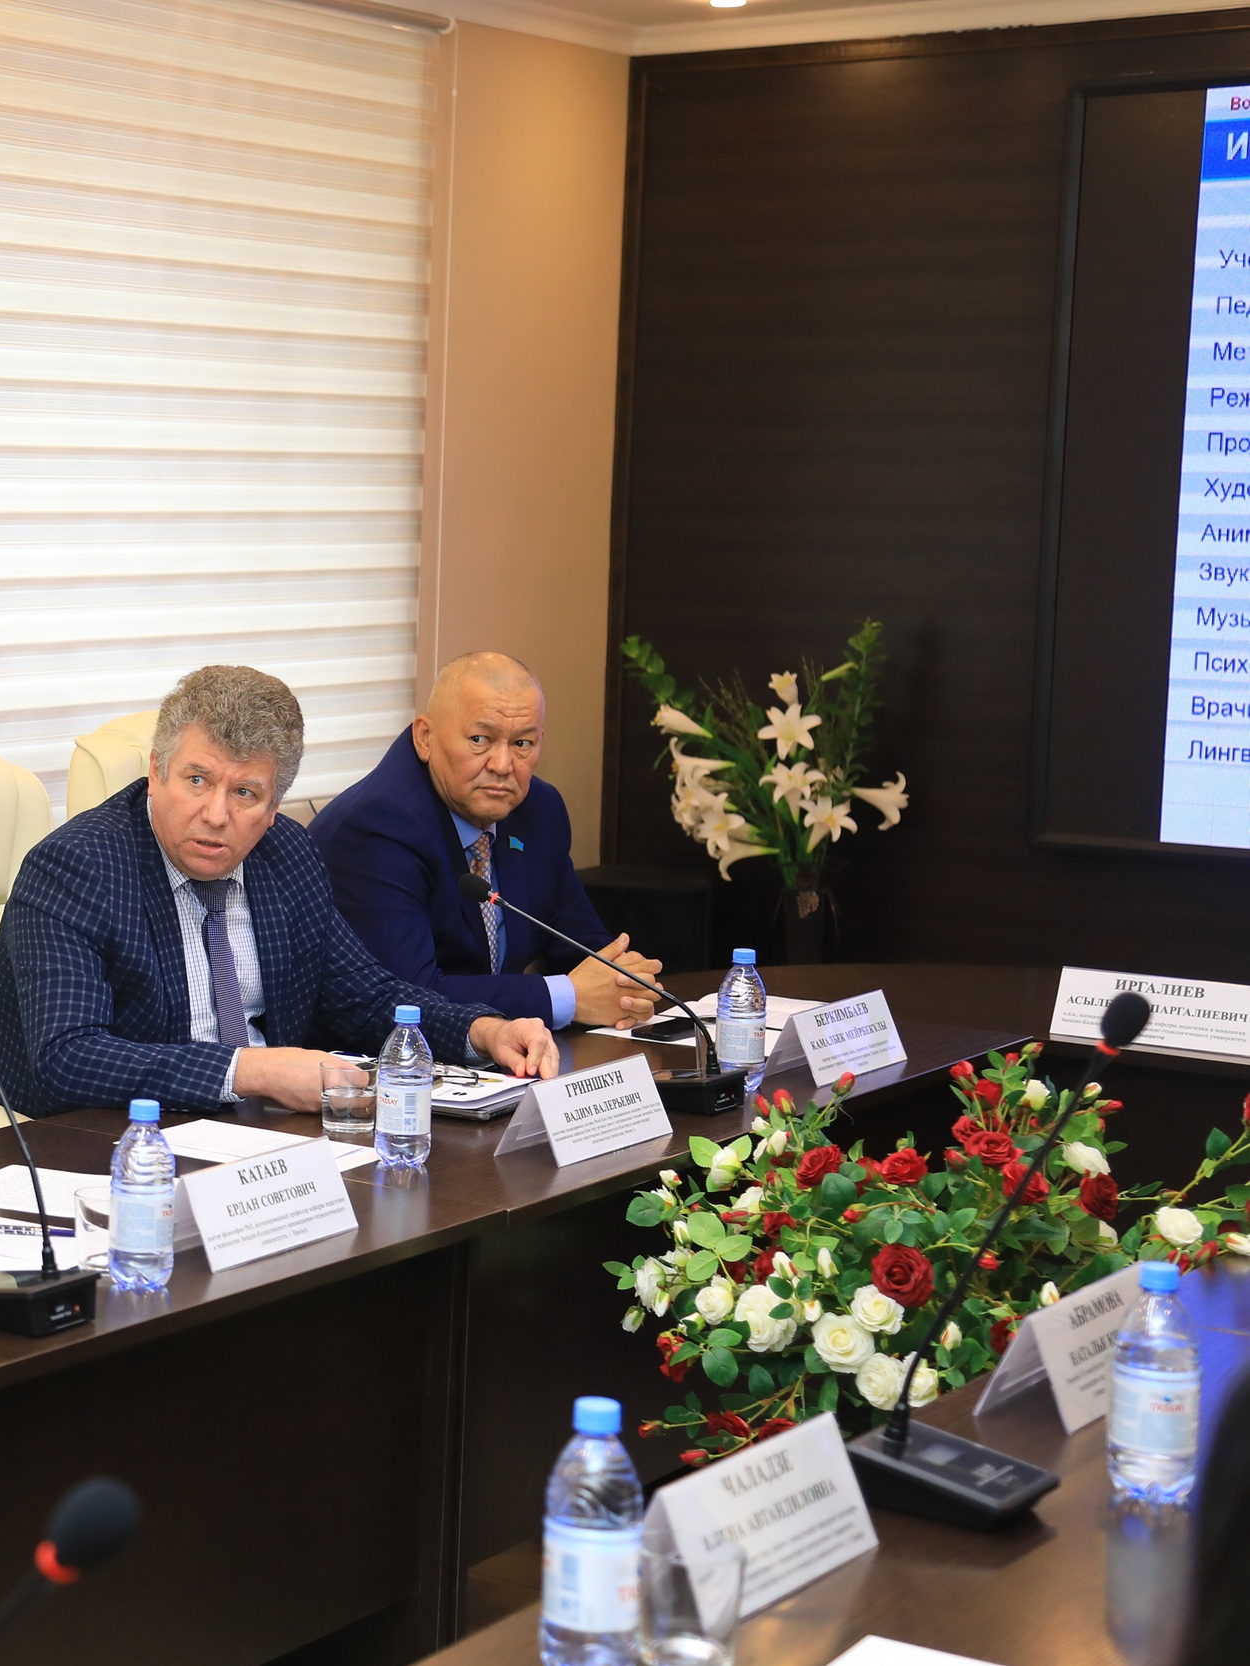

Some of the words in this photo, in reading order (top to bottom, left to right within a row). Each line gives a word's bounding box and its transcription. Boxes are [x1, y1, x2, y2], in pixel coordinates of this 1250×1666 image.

[1226, 131, 1249, 161] И
[1219, 248, 1250, 269] Уч
[1208, 432, 1250, 456] Про
[1204, 477, 1250, 503] Худ
[1200, 562, 1250, 587] Звук
[1194, 651, 1249, 674] Псих
[1191, 695, 1250, 720] Врач
[1187, 739, 1250, 763] Лингв
[1114, 978, 1205, 999] ИРГАЛИЕВ
[814, 1002, 869, 1028] БЕРКИМБАЕВ
[1066, 995, 1113, 1008] АСЫЛБ
[1150, 1004, 1248, 1023] ПАРГАЛИЕВИЧ
[810, 1031, 846, 1050] КАМАЛБЕК
[565, 1070, 625, 1098] ГРИНШКУН
[564, 1105, 593, 1124] ВАДИМ
[593, 1092, 642, 1116] ВАЛЕРЬЕВИЧ
[237, 1158, 288, 1186] КАТАЕВ
[226, 1199, 260, 1218] ЕРДАН
[261, 1181, 318, 1207] СОВЕТОВИЧ
[1070, 1289, 1125, 1329] АБРАМОВА
[1069, 1336, 1107, 1367] НАТАЛЬЯ
[721, 1449, 794, 1498] ЧАЛАДЗЕ
[748, 1478, 838, 1533] АВТАНДИЛОВНА
